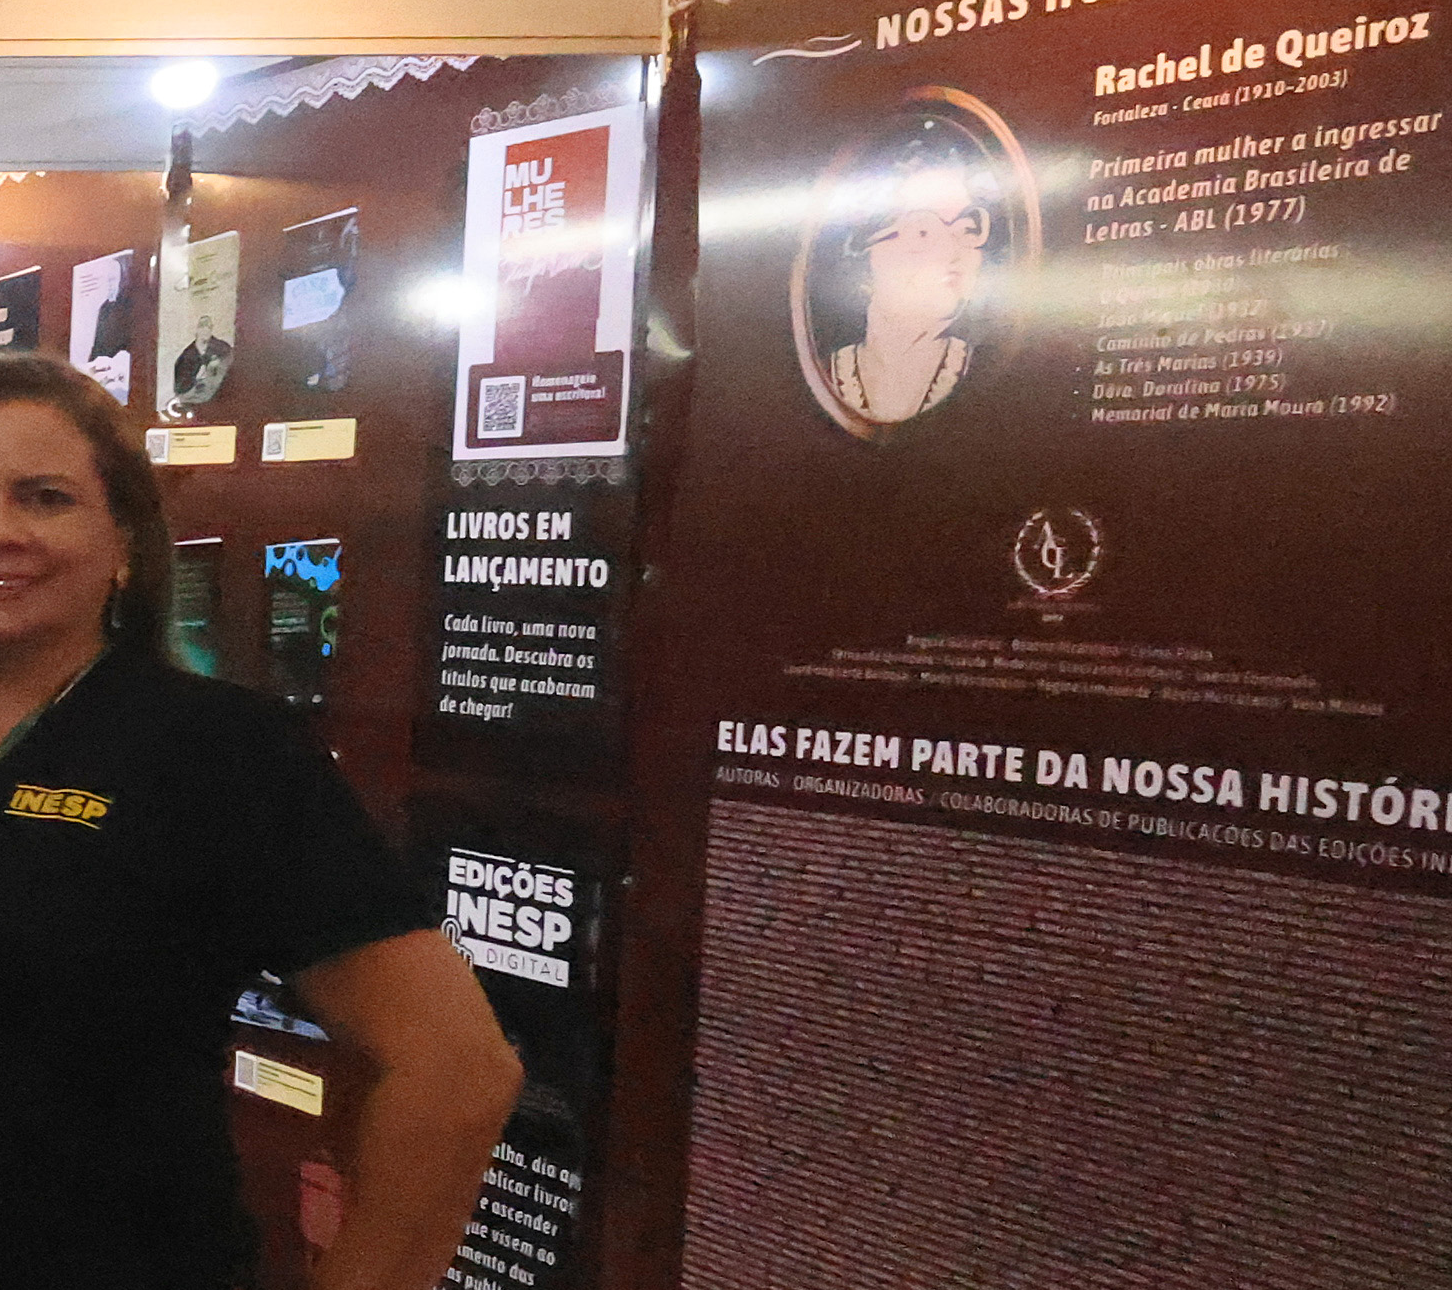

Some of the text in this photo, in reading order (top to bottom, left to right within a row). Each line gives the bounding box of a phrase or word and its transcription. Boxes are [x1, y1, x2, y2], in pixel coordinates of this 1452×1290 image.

[1094, 11, 1430, 96] Rachel de Queiroz
[1093, 100, 1168, 126] Fortaleza
[1182, 87, 1230, 112] Ceará
[1089, 110, 1442, 180] Primeira mulher a ingressar
[505, 157, 553, 190] MU
[1087, 149, 1411, 212] na Academia Brasileira de
[503, 181, 566, 215] LHE
[1085, 196, 1306, 245] Letras ABL (1977)
[1194, 251, 1244, 272] obras
[1157, 353, 1217, 372] Marias
[1222, 347, 1283, 369] (1939)
[1226, 372, 1287, 395] (1975)
[1091, 391, 1397, 424] Memorial de Maria Moura (1992)
[447, 512, 572, 540] LIVROS EM
[444, 555, 608, 592] LANÇAMENTO
[444, 614, 596, 640] Cada livro, uma nova
[441, 641, 594, 669] jornada. Descubra os
[490, 676, 516, 693] que
[520, 677, 595, 699] acabaram
[439, 694, 514, 721] de chegar!
[717, 720, 787, 757] ELAS
[796, 727, 900, 769] FAZEM
[911, 738, 1025, 783] PARTE
[1036, 750, 1088, 789] DA
[1102, 757, 1243, 808] NOSSA
[10, 789, 108, 820] INESP
[717, 766, 779, 788] AUTORAS
[794, 775, 925, 805] ORGANIZADORAS
[941, 792, 1093, 826] COLABORADORAS
[1099, 810, 1121, 830] DE
[1270, 831, 1311, 855] DAS
[1421, 851, 1452, 874] IN
[449, 856, 573, 907] EDIÇÕES
[446, 889, 572, 951] INESP
[487, 948, 564, 982] DIGITAL
[532, 1156, 556, 1178] dia
[479, 1196, 558, 1237] e ascender
[491, 1229, 556, 1266] visem ao
